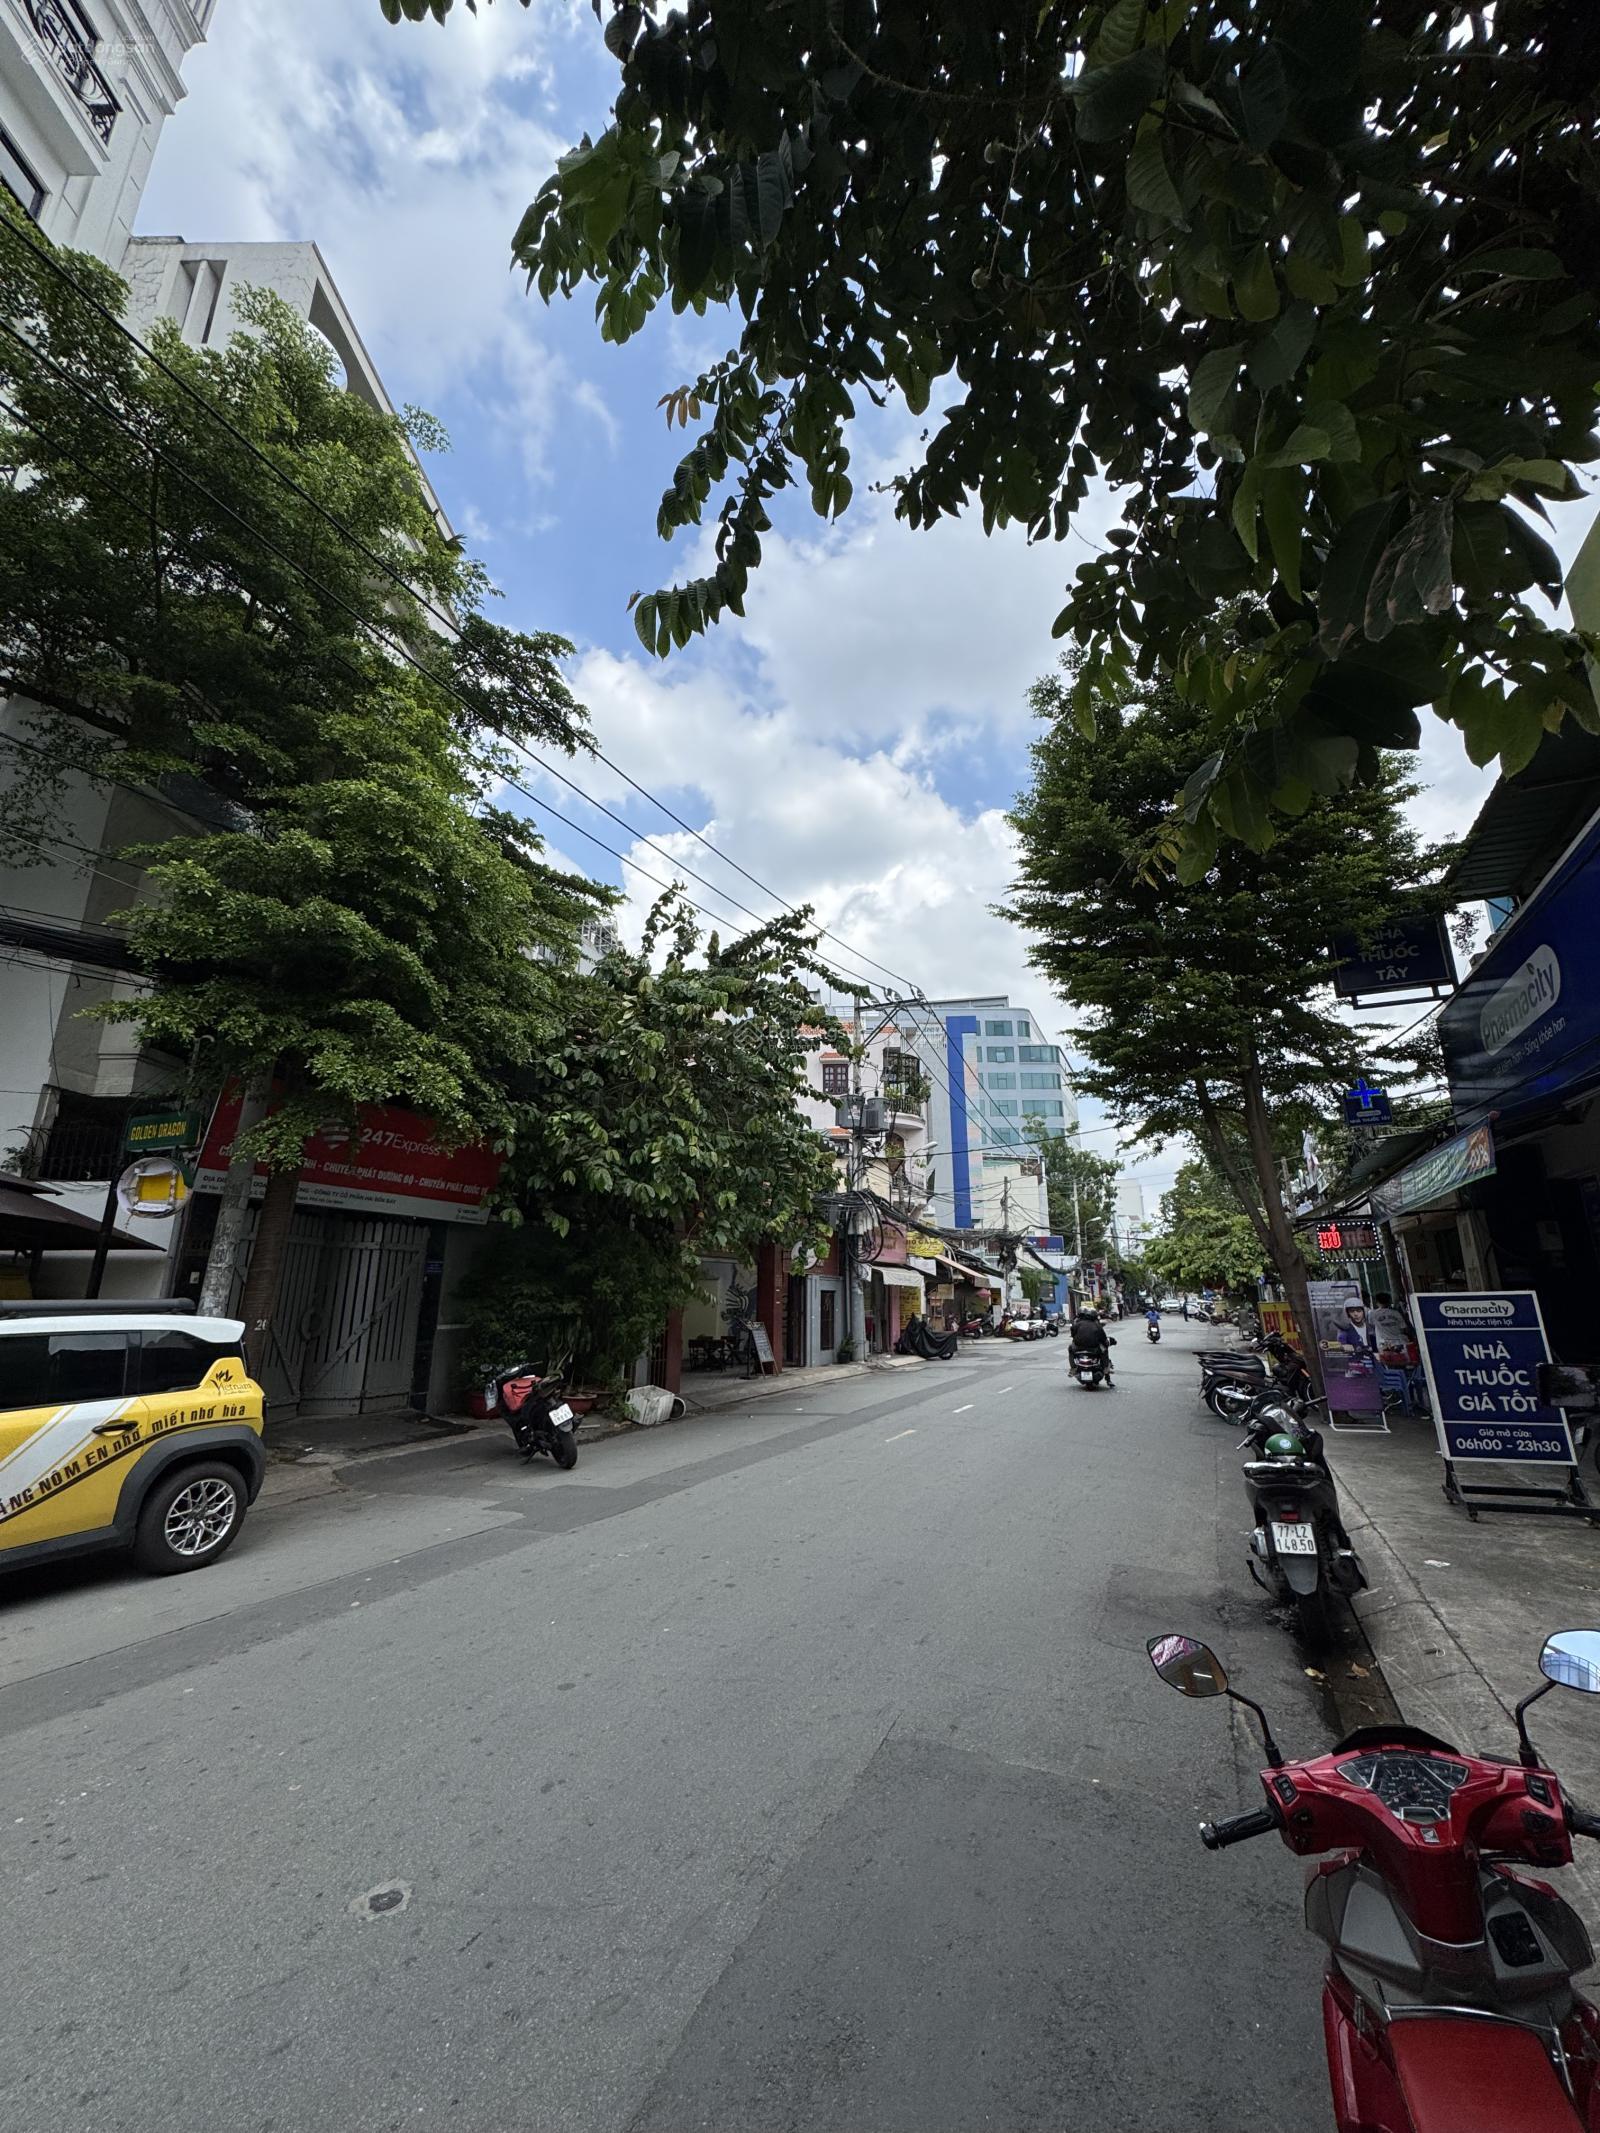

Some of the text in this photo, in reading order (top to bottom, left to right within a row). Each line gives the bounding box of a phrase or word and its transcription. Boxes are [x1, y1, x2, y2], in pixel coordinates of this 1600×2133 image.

[1358, 940, 1421, 963] THUỐC
[1375, 965, 1409, 981] TÂY
[1482, 962, 1556, 1050] Pharmacity
[130, 1120, 187, 1141] GOLDEN DRAGON
[360, 1127, 441, 1156] 247Express
[1324, 1249, 1347, 1260] NAM
[1444, 1301, 1509, 1315] Pharmacity
[1447, 1318, 1464, 1326] Nhà
[1462, 1340, 1512, 1360] NHÀ
[1454, 1363, 1530, 1386] THUỐC
[209, 1378, 252, 1397] Vietnam
[1458, 1389, 1538, 1412] GIÁ TỐT
[39, 1461, 82, 1495] NÔM
[85, 1445, 109, 1467] EN
[113, 1425, 142, 1452] nhớ
[151, 1409, 185, 1434] miết
[190, 1404, 217, 1422] nhớ
[1456, 1438, 1502, 1450] 06h00
[1516, 1439, 1561, 1452] 23h30
